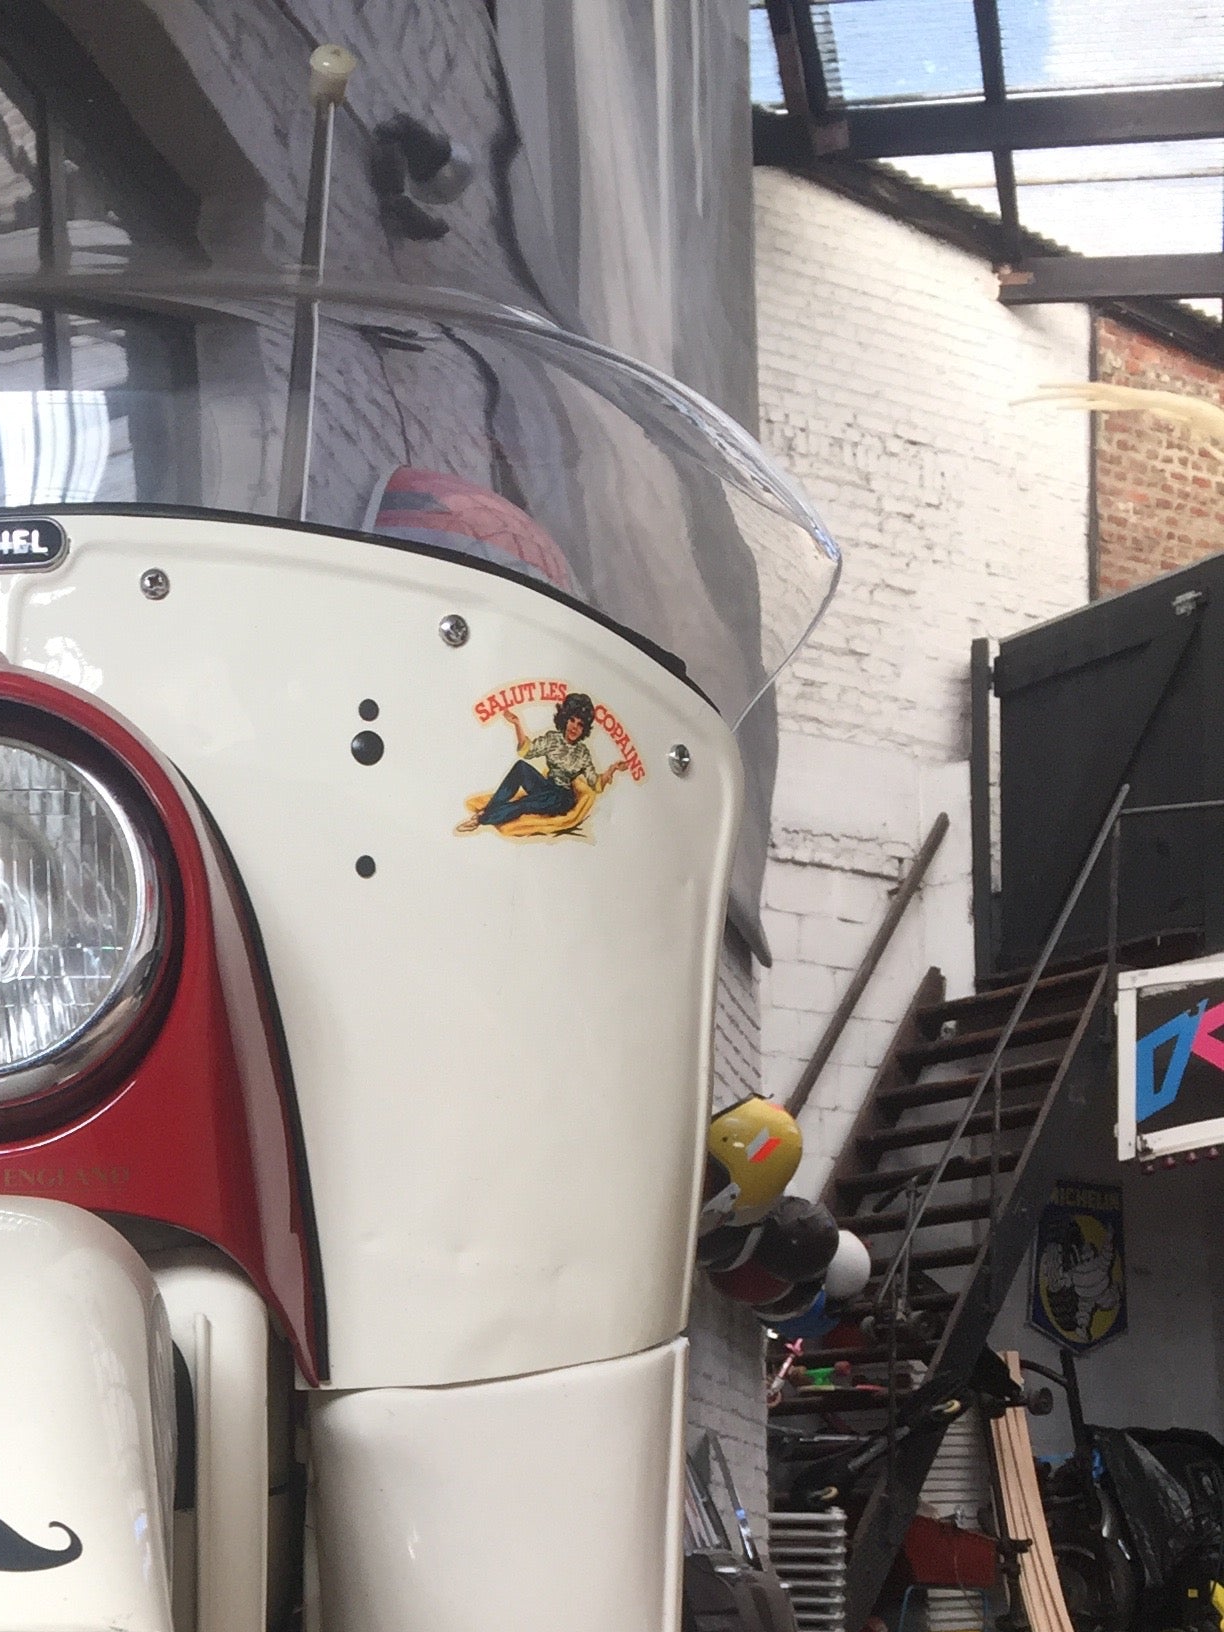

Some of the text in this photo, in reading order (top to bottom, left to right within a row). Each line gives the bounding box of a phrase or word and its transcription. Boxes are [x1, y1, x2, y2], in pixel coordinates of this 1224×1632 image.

[475, 682, 645, 781] SALUT LES COPAINS
[3, 1166, 130, 1188] ENGLAND
